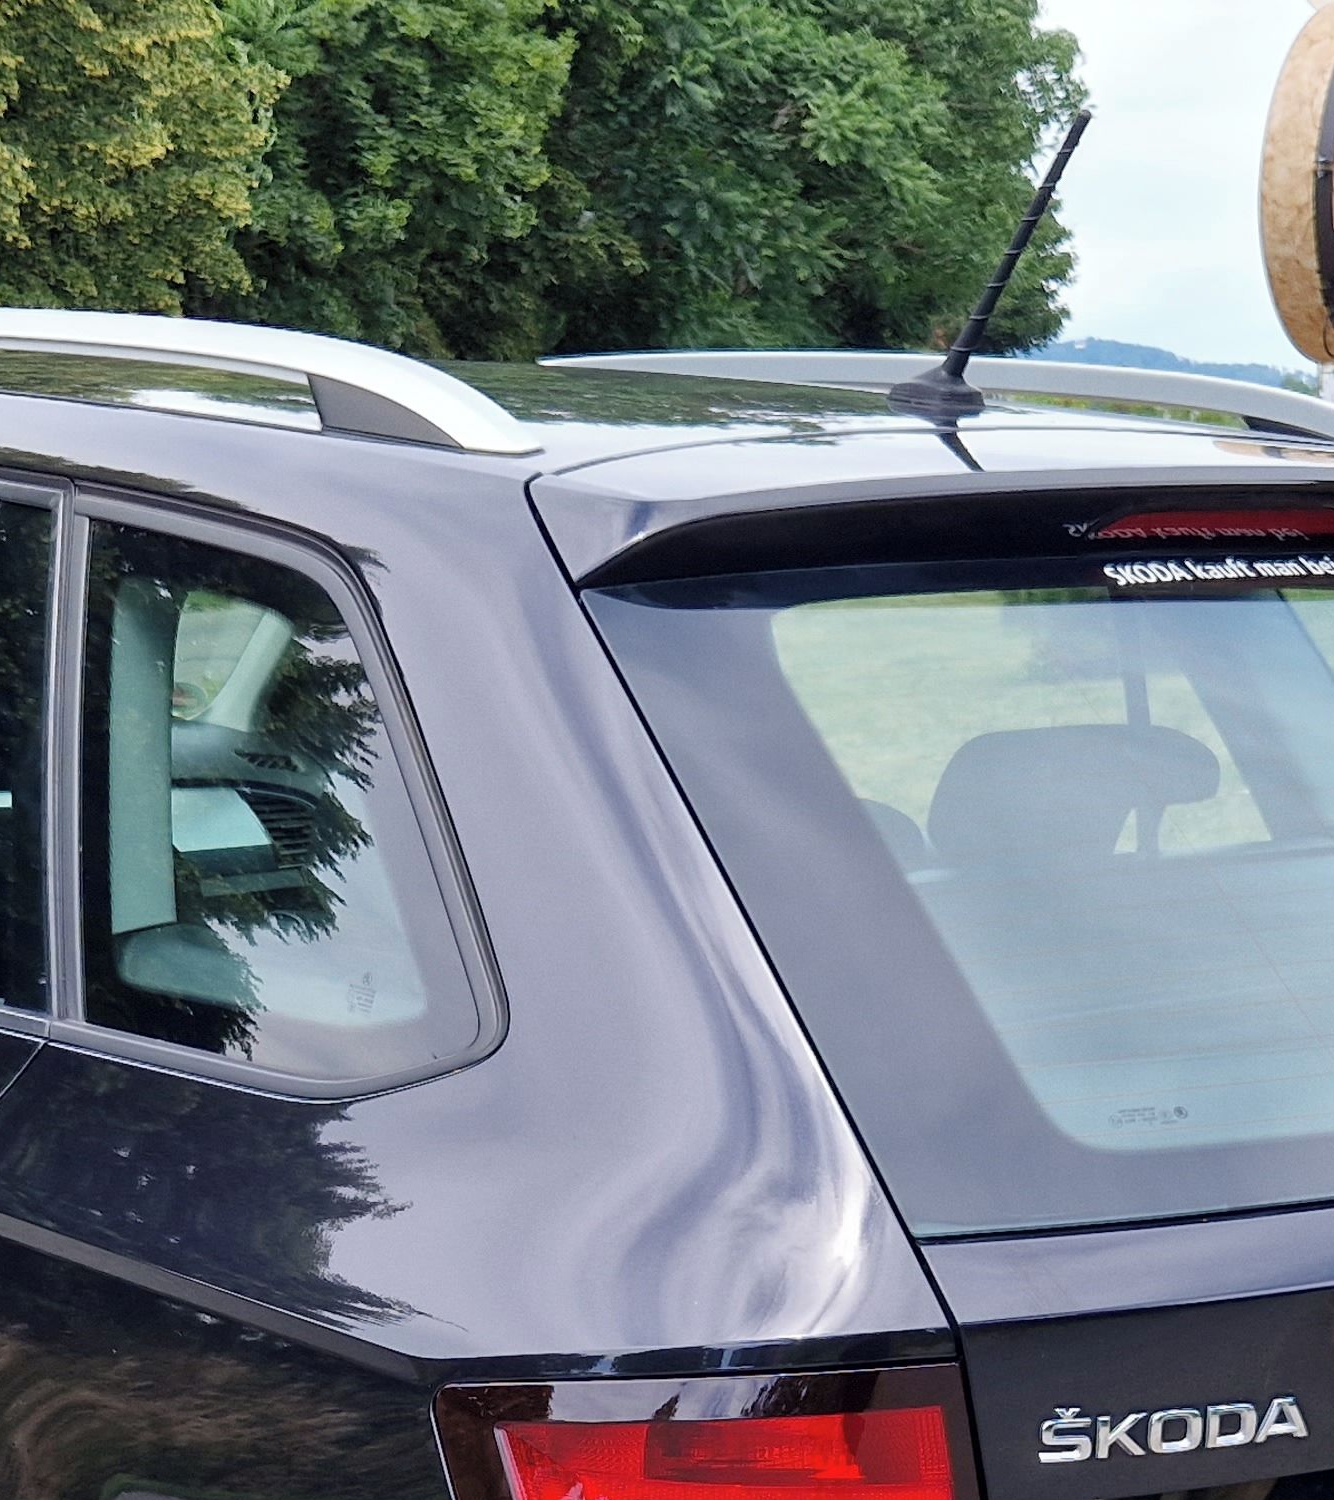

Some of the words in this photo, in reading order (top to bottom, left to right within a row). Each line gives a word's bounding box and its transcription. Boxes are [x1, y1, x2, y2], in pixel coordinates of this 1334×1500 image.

[1184, 556, 1257, 580] kauft
[1253, 560, 1307, 578] man
[1038, 1396, 1309, 1464] ŠKODA
